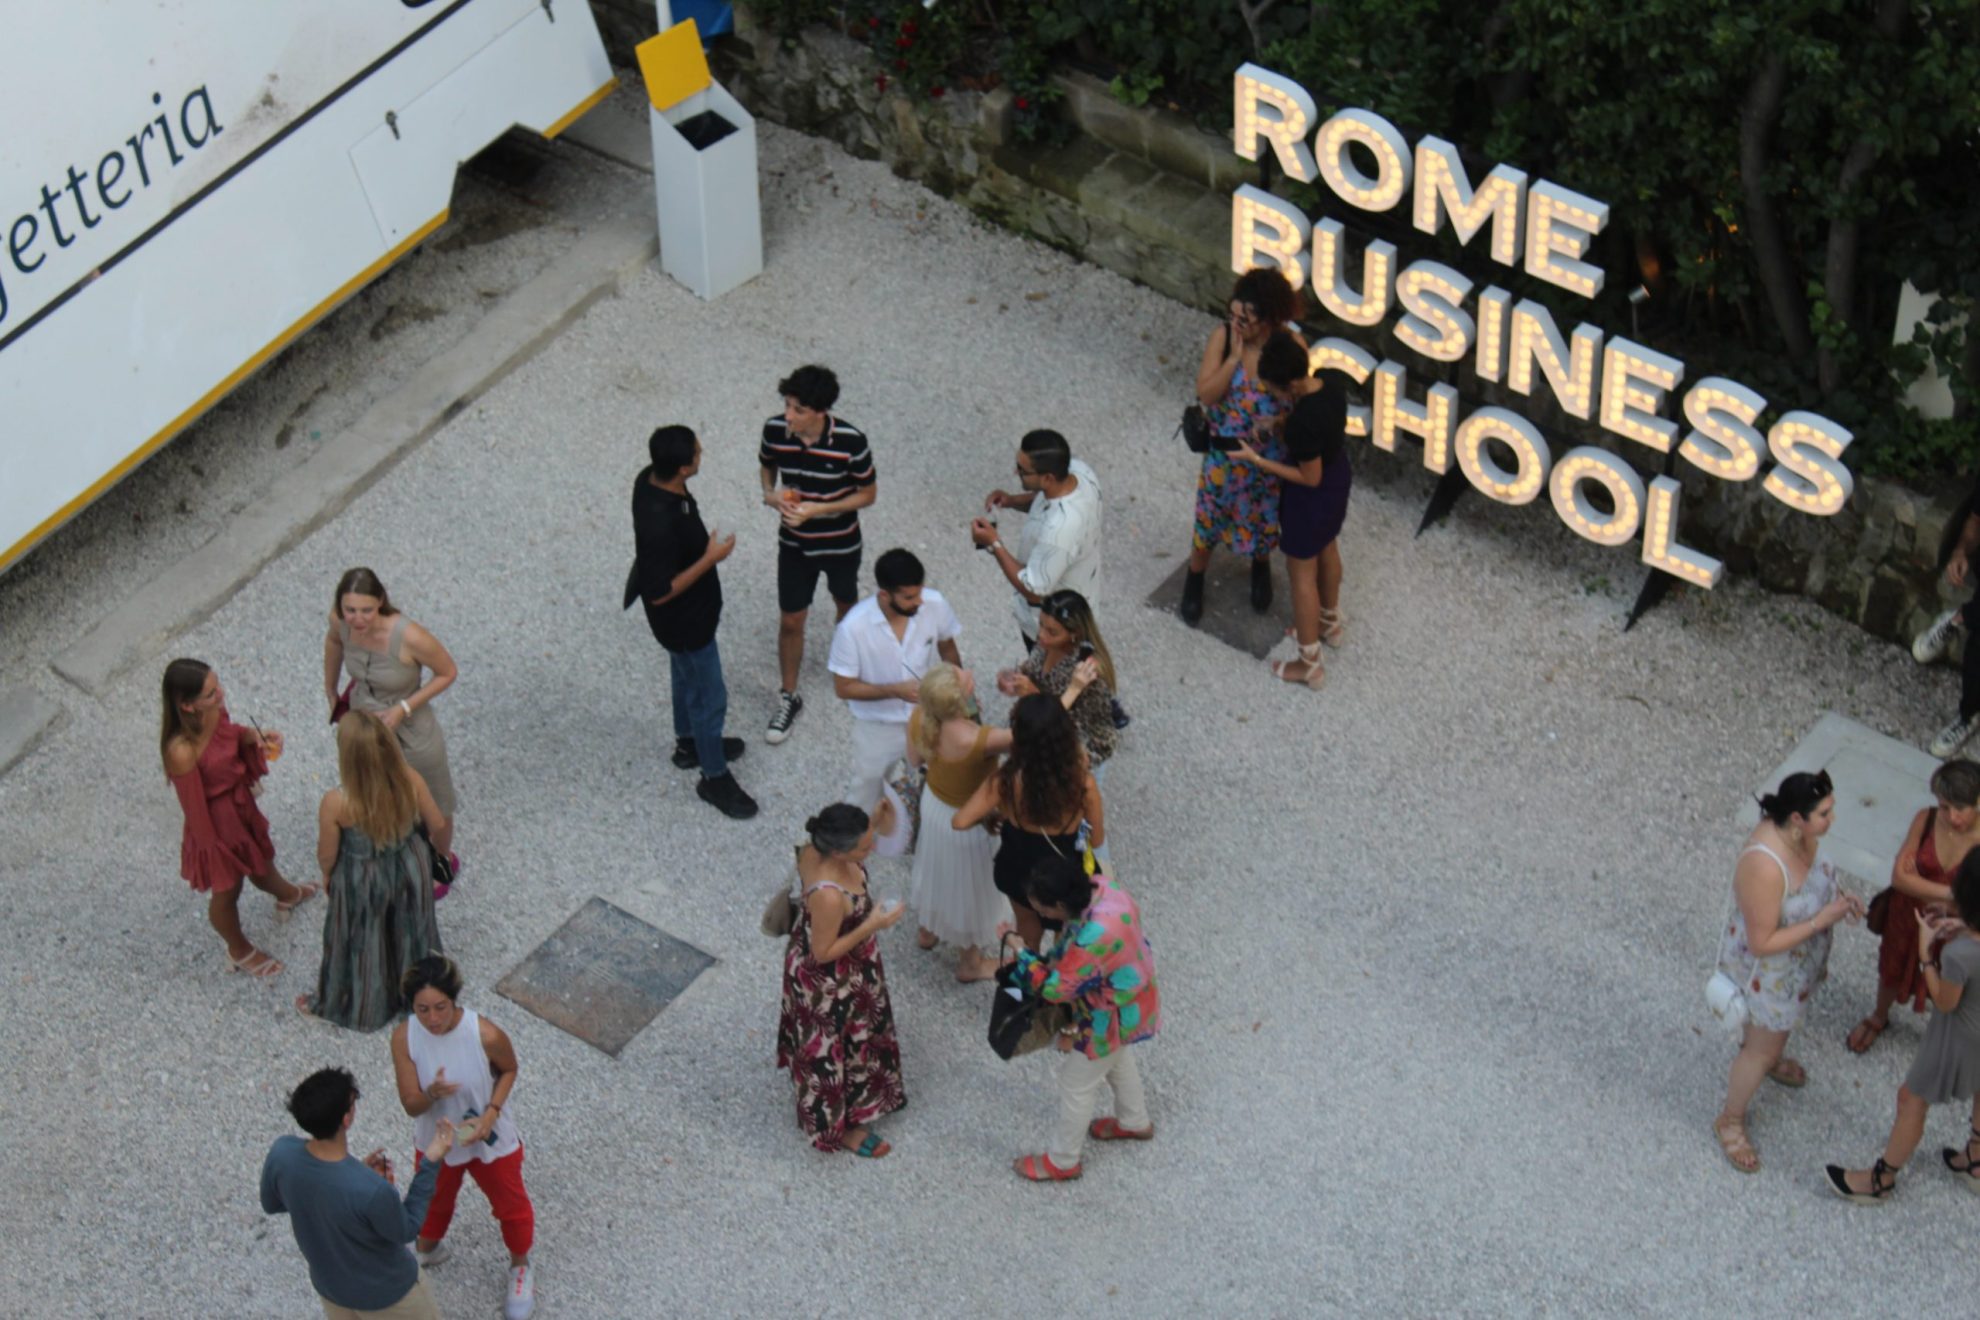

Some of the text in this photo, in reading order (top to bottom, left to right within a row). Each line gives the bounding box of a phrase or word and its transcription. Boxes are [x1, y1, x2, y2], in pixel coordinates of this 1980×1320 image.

[0, 84, 224, 324] etteria
[1233, 62, 1610, 299] ROME
[1231, 183, 1855, 517] BUSINESS
[1287, 320, 1723, 591] CHOOL
